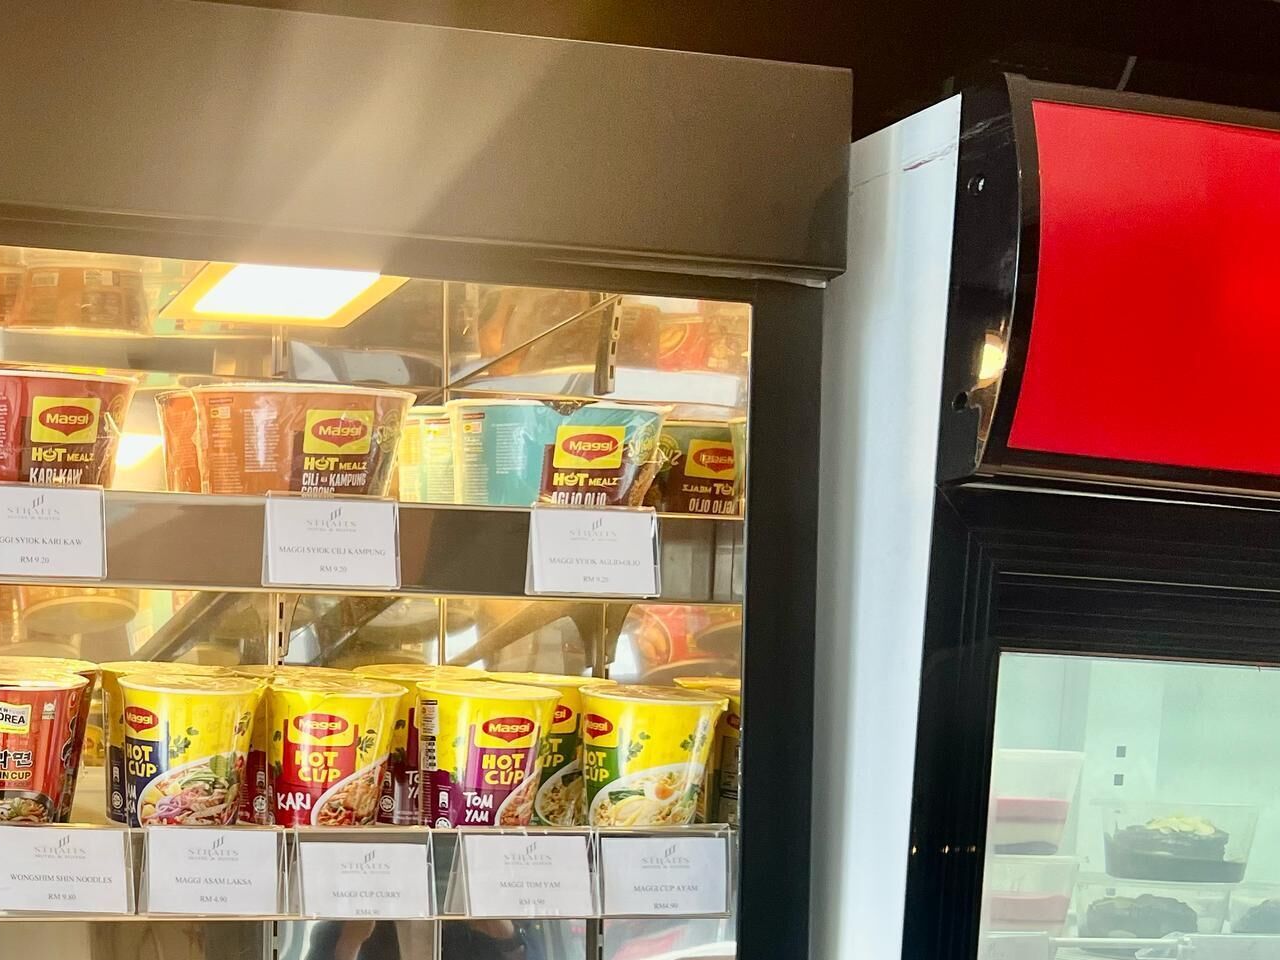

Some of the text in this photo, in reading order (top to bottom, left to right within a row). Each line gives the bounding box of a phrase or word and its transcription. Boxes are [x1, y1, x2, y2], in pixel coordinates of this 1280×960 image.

[46, 413, 89, 425] Maggi
[318, 425, 361, 437] Maggi
[569, 440, 613, 451] Maggi
[32, 447, 94, 462] HOT MEALZ
[304, 456, 368, 471] HOT MEALZ
[329, 473, 367, 486] KAMPUNG
[553, 473, 618, 486] HOT MEALZ
[348, 548, 386, 556] KAMPUNG
[298, 719, 342, 731] Maggi
[488, 722, 531, 733] Maggi
[295, 751, 339, 766] HOT
[482, 753, 525, 769] HOT
[128, 760, 157, 777] CUP
[298, 766, 342, 783] CUP
[10, 771, 32, 780] CUP
[484, 769, 524, 785] CUP
[277, 792, 311, 811] KARI
[464, 810, 489, 823] YAM
[226, 878, 252, 886] LAKSA
[359, 890, 374, 898] CUP
